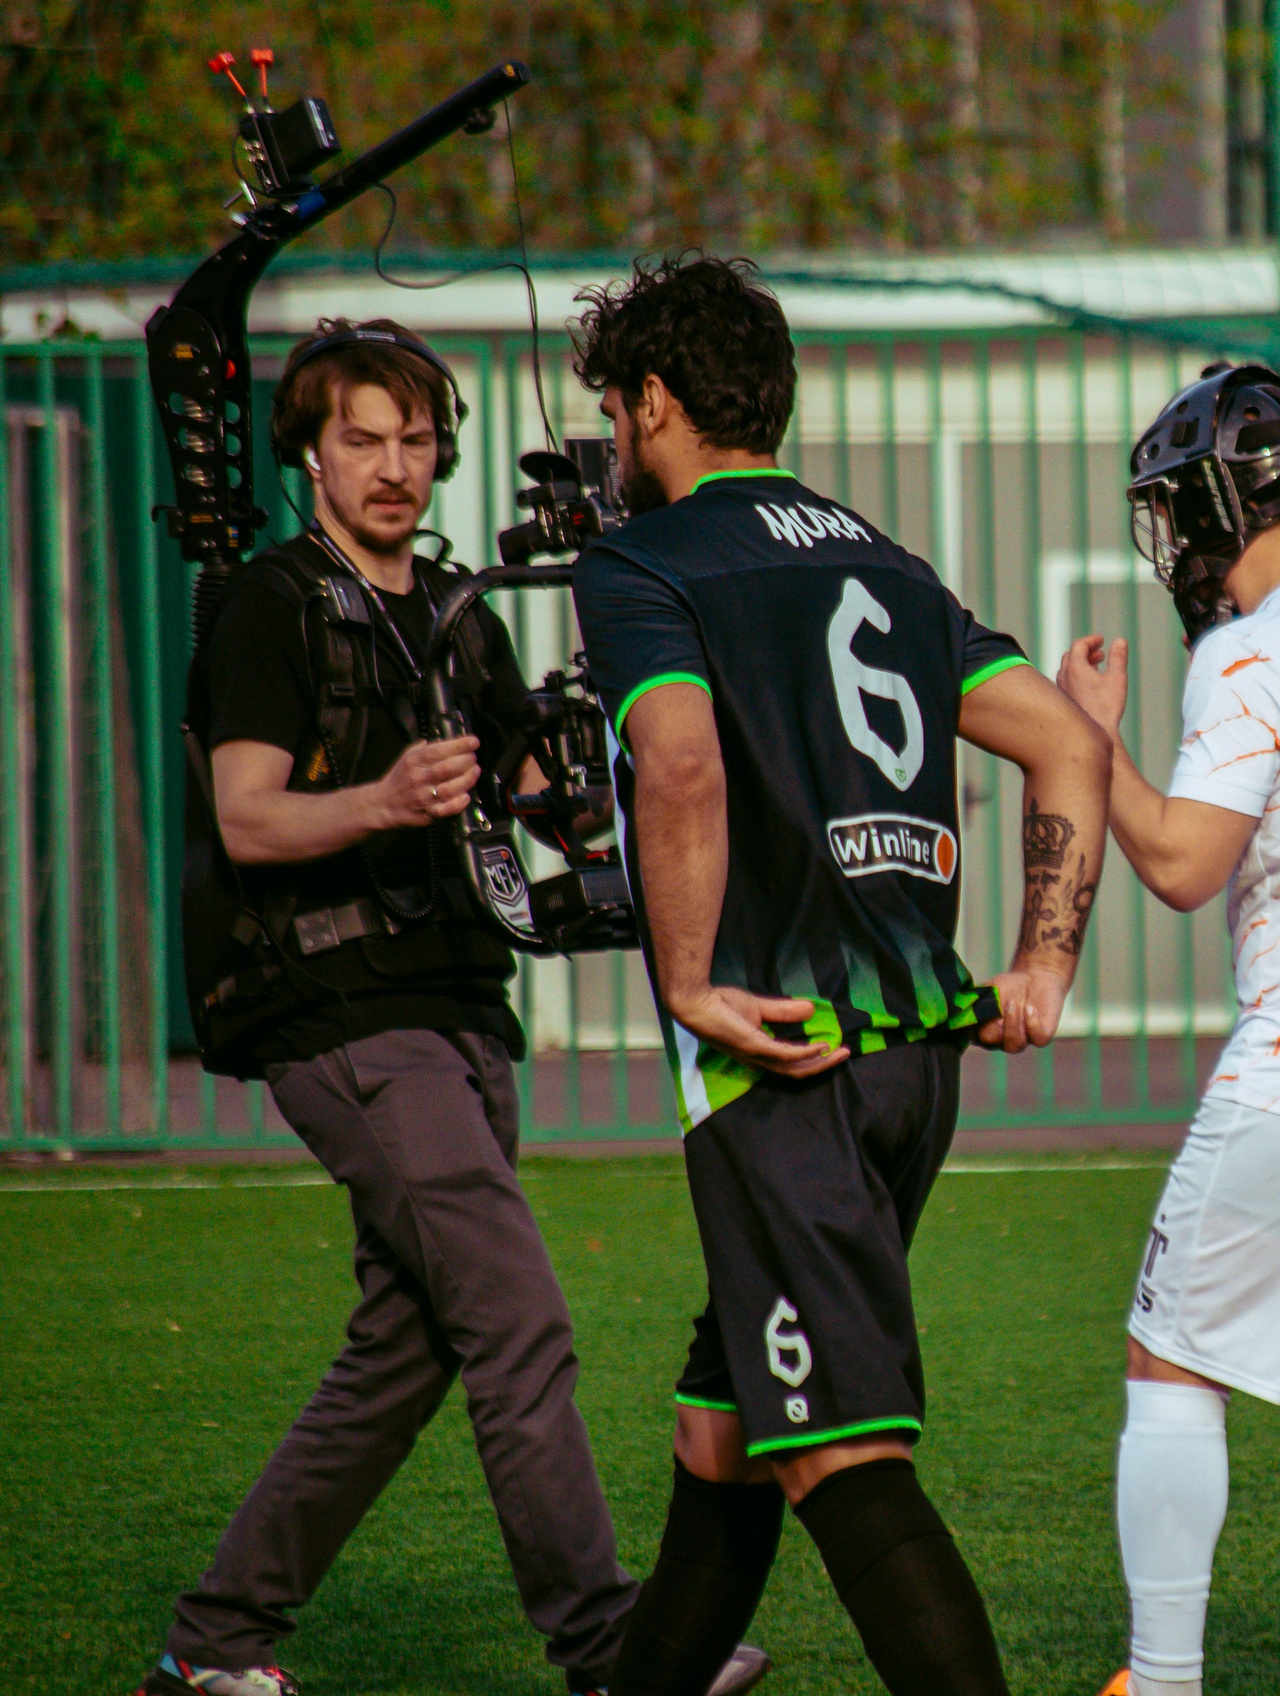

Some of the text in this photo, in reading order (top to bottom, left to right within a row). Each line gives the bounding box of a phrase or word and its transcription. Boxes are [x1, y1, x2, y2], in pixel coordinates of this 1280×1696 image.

[754, 501, 872, 548] MURA
[826, 576, 925, 792] 6
[833, 827, 930, 865] Winline
[765, 1296, 813, 1388] 6
